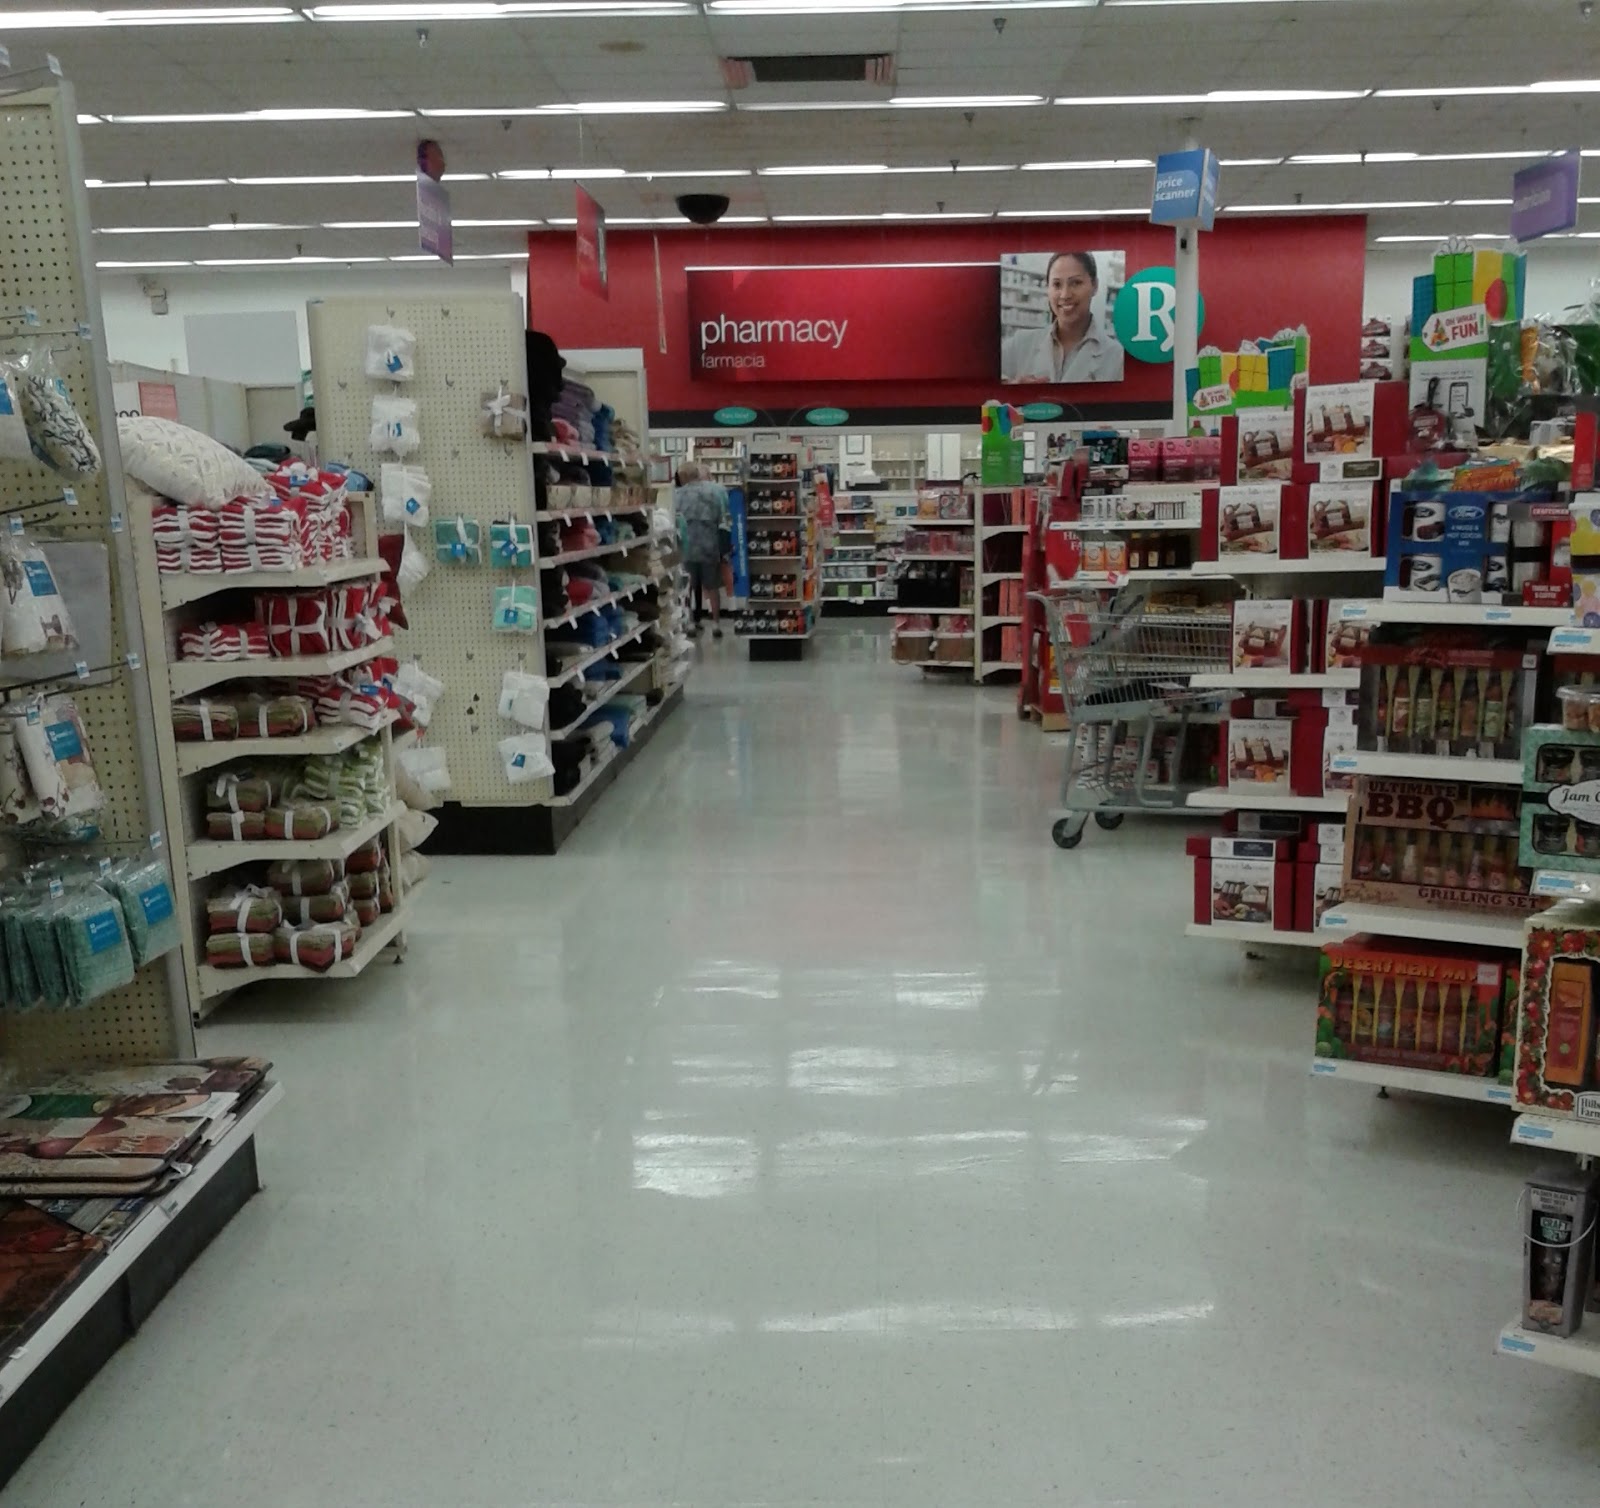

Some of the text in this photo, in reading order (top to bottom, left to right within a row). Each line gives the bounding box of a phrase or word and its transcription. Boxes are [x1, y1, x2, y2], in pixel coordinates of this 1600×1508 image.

[1156, 175, 1183, 191] price
[1155, 189, 1196, 201] scanner
[1456, 312, 1477, 324] WHAT
[701, 313, 848, 350] pharmacy
[702, 353, 765, 368] farmacia
[696, 437, 733, 447] PICK UP
[1369, 781, 1456, 797] ULTIMATE
[1562, 788, 1590, 803] Jam
[1366, 793, 1454, 829] BBQ
[1418, 887, 1539, 908] GRILLING SET
